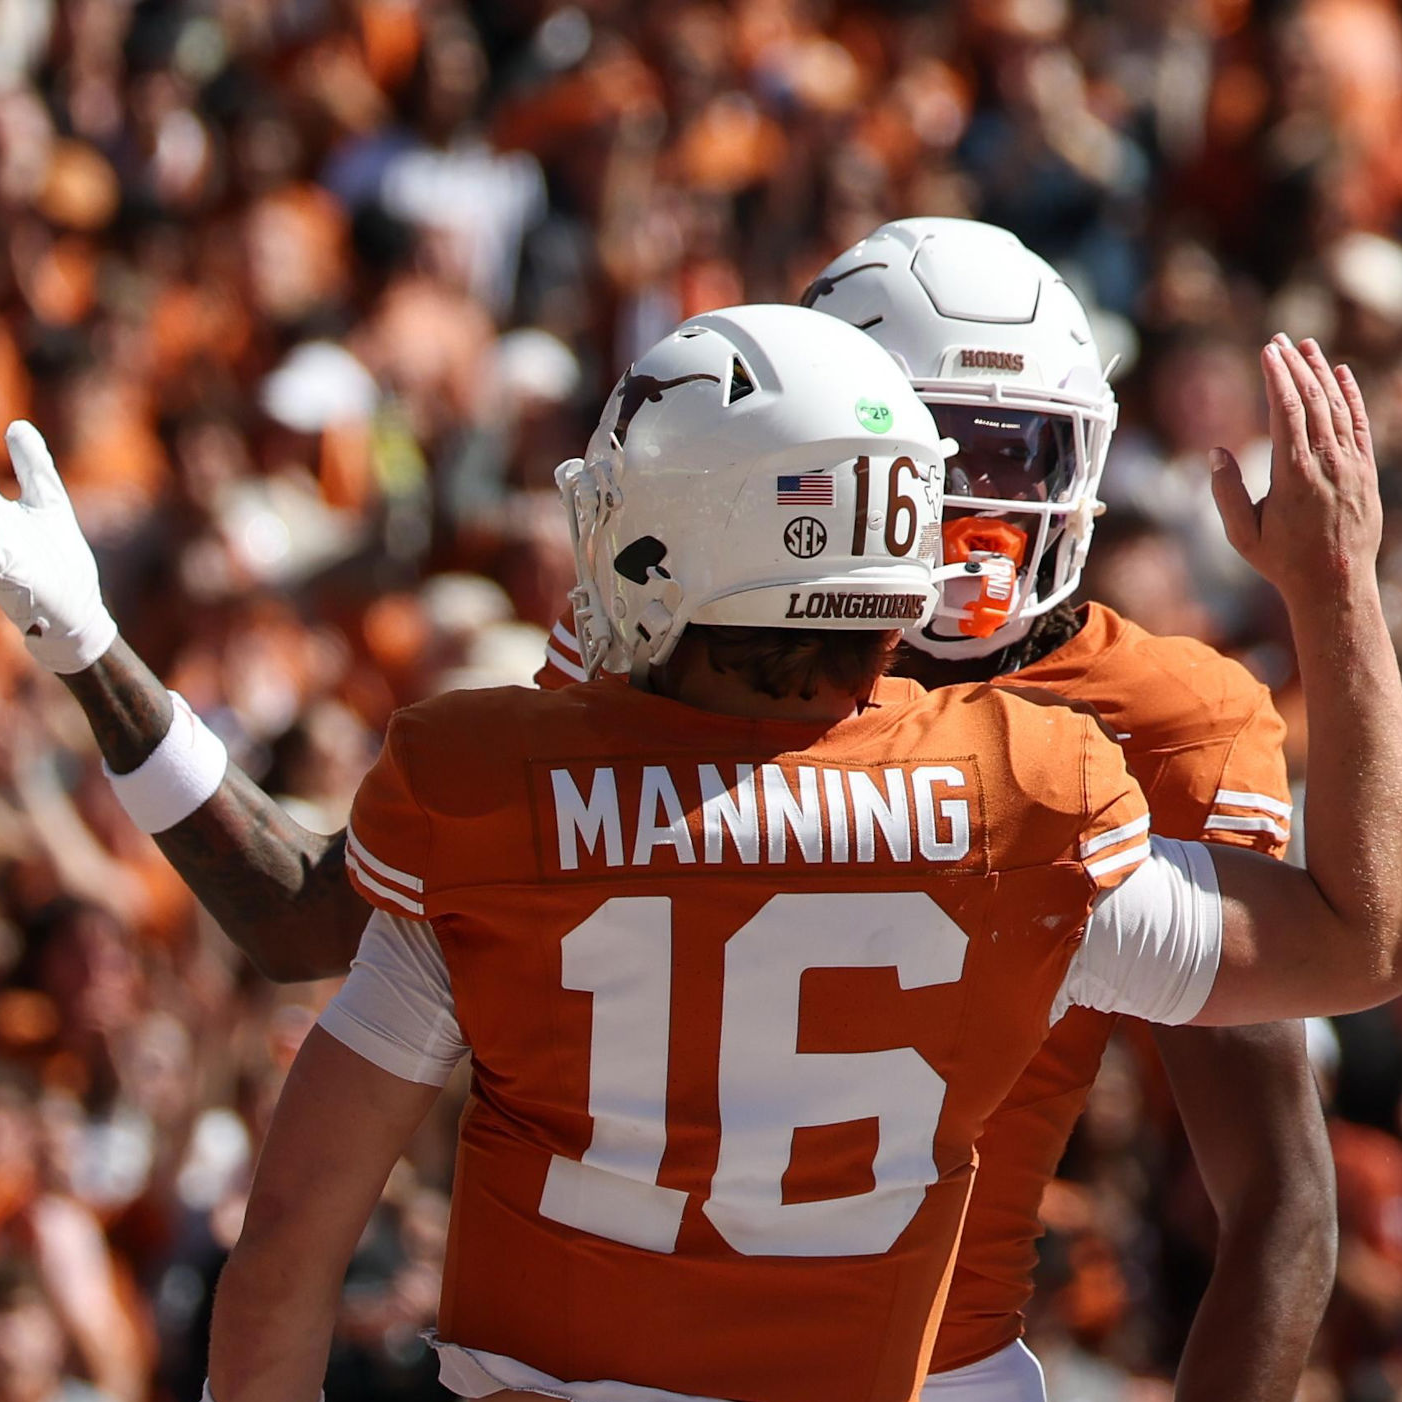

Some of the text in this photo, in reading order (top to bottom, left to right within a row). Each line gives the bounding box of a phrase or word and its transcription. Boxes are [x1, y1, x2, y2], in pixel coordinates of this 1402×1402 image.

[961, 350, 1024, 372] HORNS
[784, 516, 827, 558] SEC
[851, 455, 919, 557] 16
[785, 592, 927, 619] LONGHORNS
[549, 763, 970, 870] MANNING
[538, 891, 970, 1257] 16
